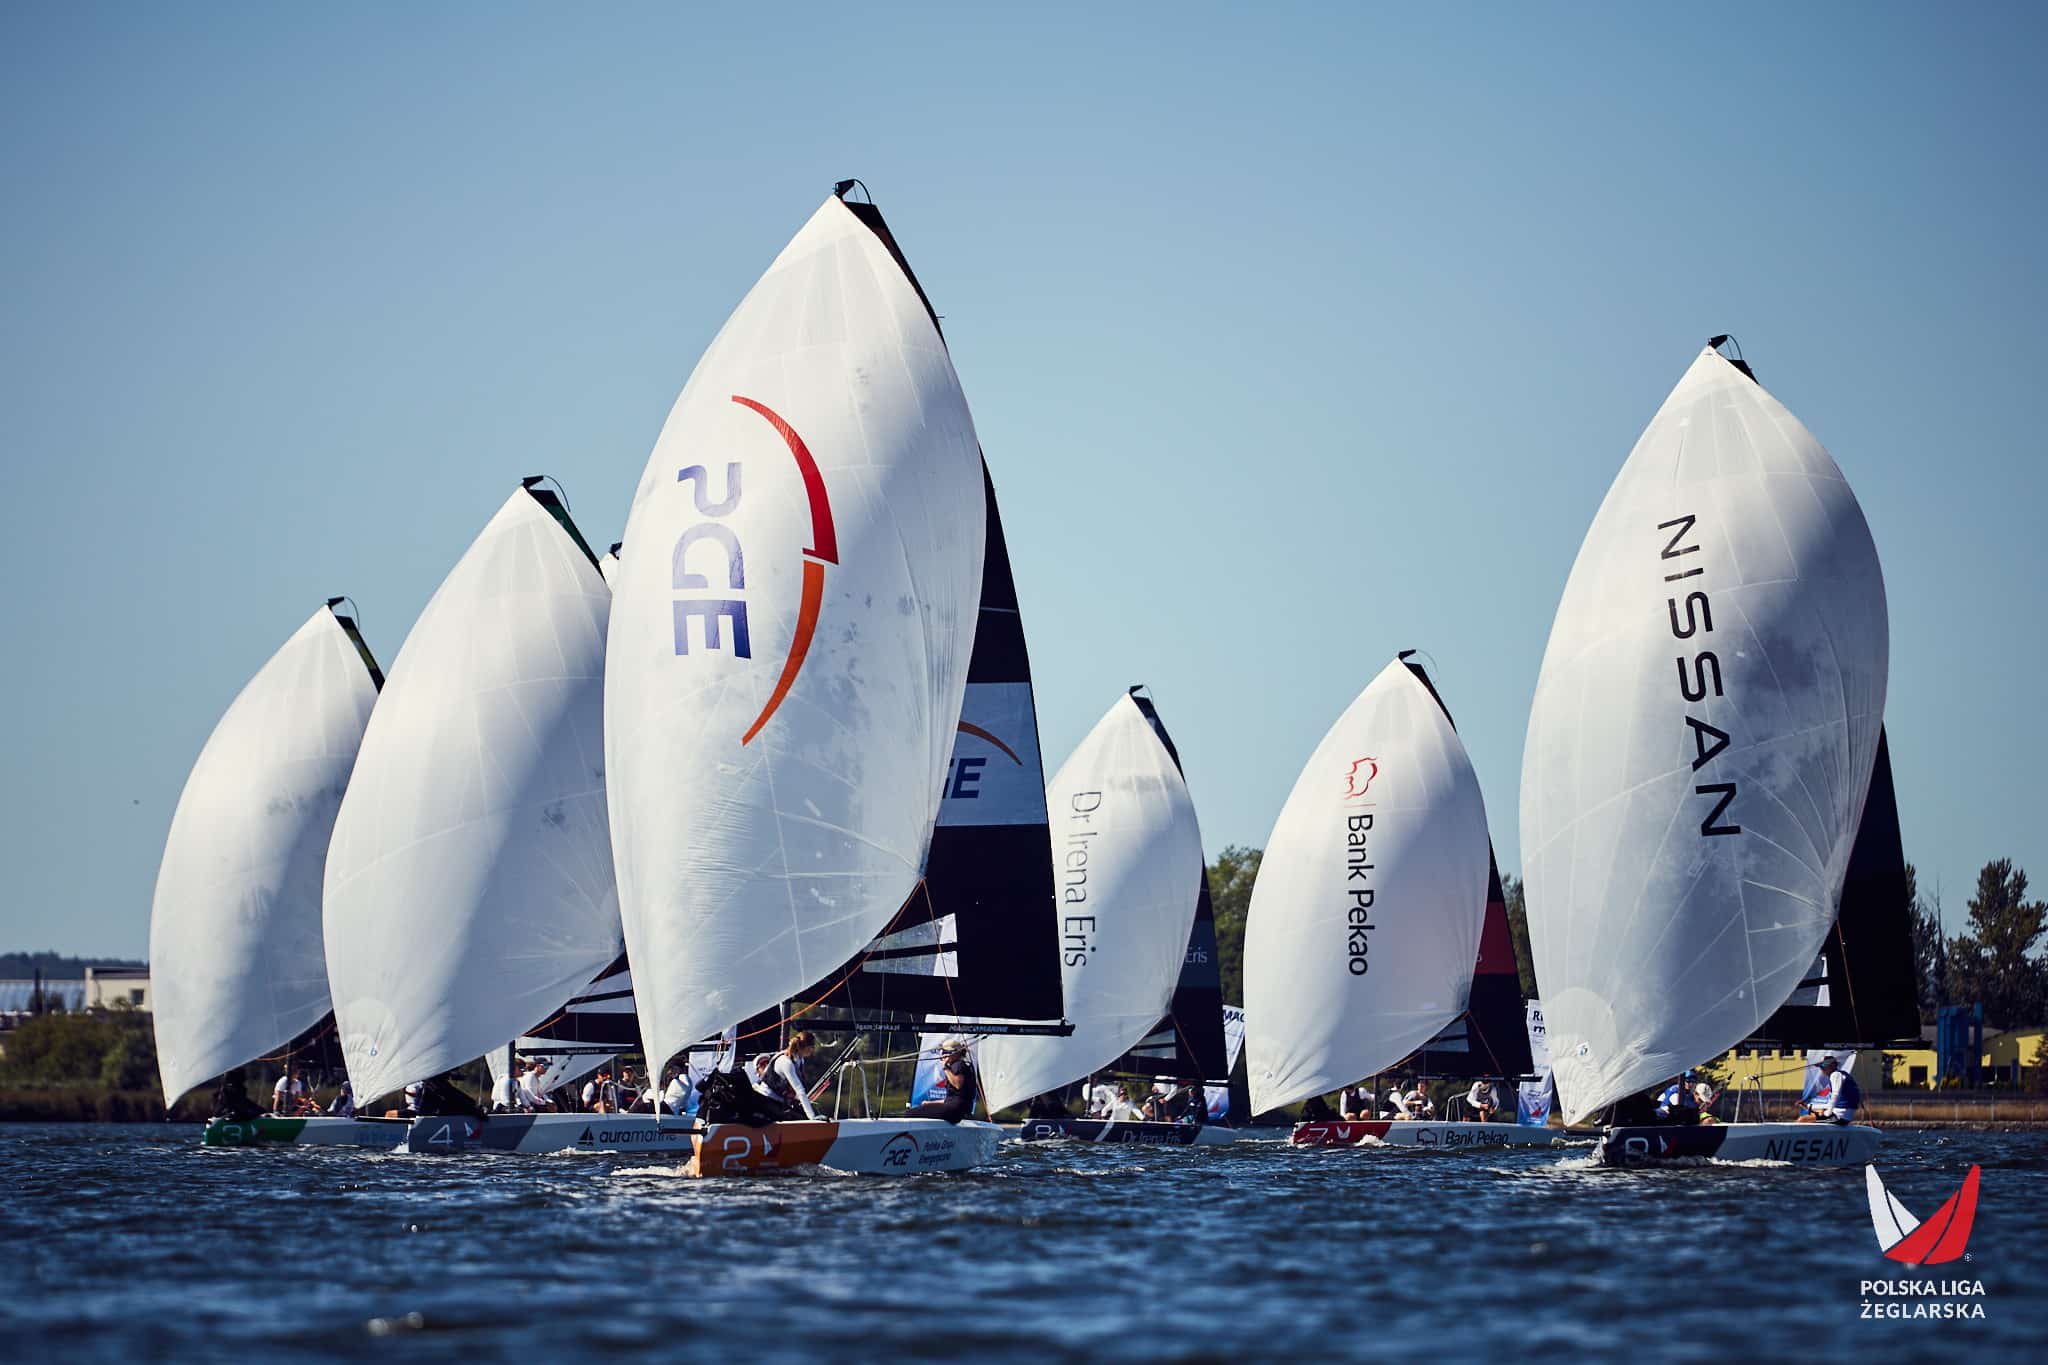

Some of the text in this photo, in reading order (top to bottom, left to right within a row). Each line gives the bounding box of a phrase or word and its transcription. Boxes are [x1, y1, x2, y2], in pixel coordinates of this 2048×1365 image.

[672, 462, 752, 659] PGE
[1657, 514, 1741, 836] NISSAN
[1064, 791, 1102, 967] Dr Irena Eris
[1347, 814, 1375, 976] Bank Pekao
[428, 1123, 453, 1144] 4
[1308, 1127, 1329, 1145] 7
[1445, 1130, 1509, 1145] Bank Pekao
[1766, 1137, 1849, 1161] NISSAN
[723, 1136, 751, 1170] 2
